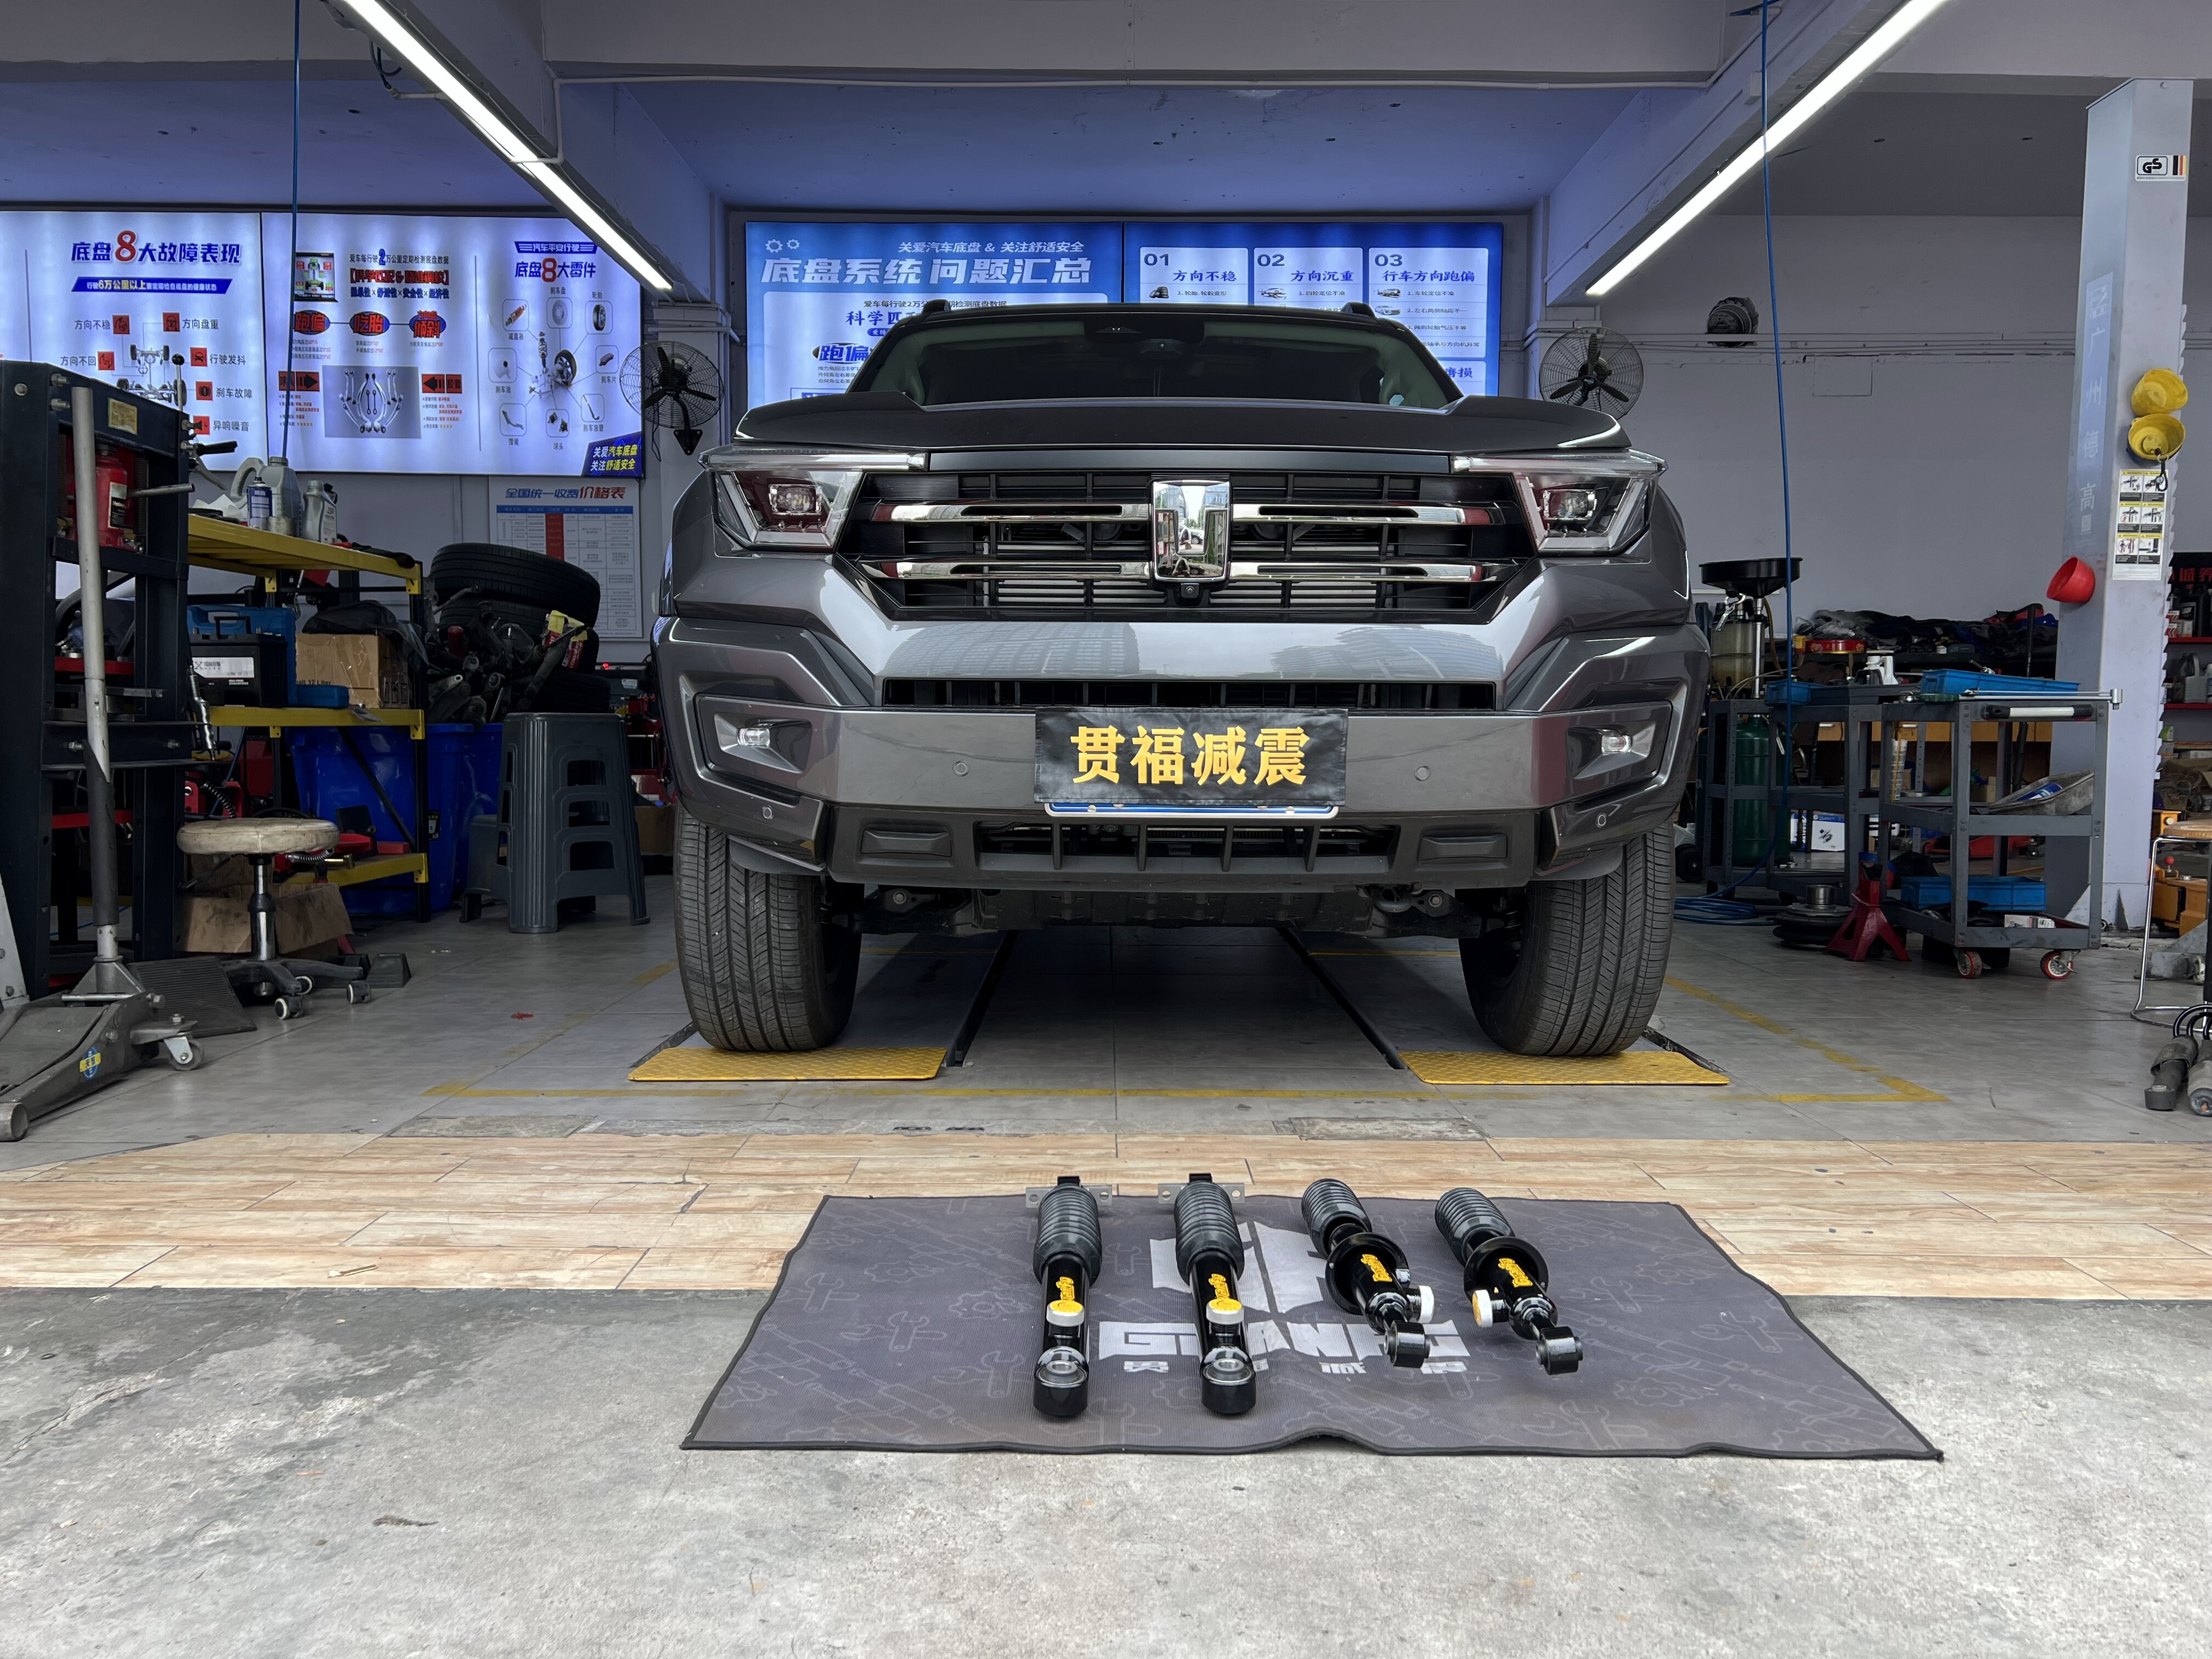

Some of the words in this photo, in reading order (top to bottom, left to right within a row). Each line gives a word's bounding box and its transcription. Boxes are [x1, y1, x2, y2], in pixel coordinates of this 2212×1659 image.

[71, 230, 240, 263] 底盘8大故障表现
[898, 241, 981, 253] 关爱汽车底盘
[1001, 241, 1085, 253] 关注舒适安全
[1144, 253, 1169, 266] 01
[1257, 253, 1285, 267] 02
[1375, 254, 1403, 267] 03
[515, 257, 596, 283] 底盘8大零件
[1172, 270, 1237, 281] 方向不稳
[1290, 270, 1354, 281] 方向沉重
[1382, 270, 1475, 282] 行车方向跑偏
[75, 319, 110, 330] 方向不稳
[295, 312, 325, 332] 跑偏
[354, 313, 383, 333] 吃胎
[414, 320, 441, 338] 倾斜
[210, 354, 246, 365] 行驶发抖
[819, 345, 869, 361] 跑偏
[60, 356, 97, 366] 方向不回
[216, 387, 252, 398] 刹车故障
[213, 420, 249, 431] 异响噪音
[593, 444, 637, 458] 关爱汽车底盘
[590, 460, 636, 471] 关注舒适安全
[505, 486, 626, 499] 全国统一收费价格表
[1070, 725, 1310, 786] 贯福减震
